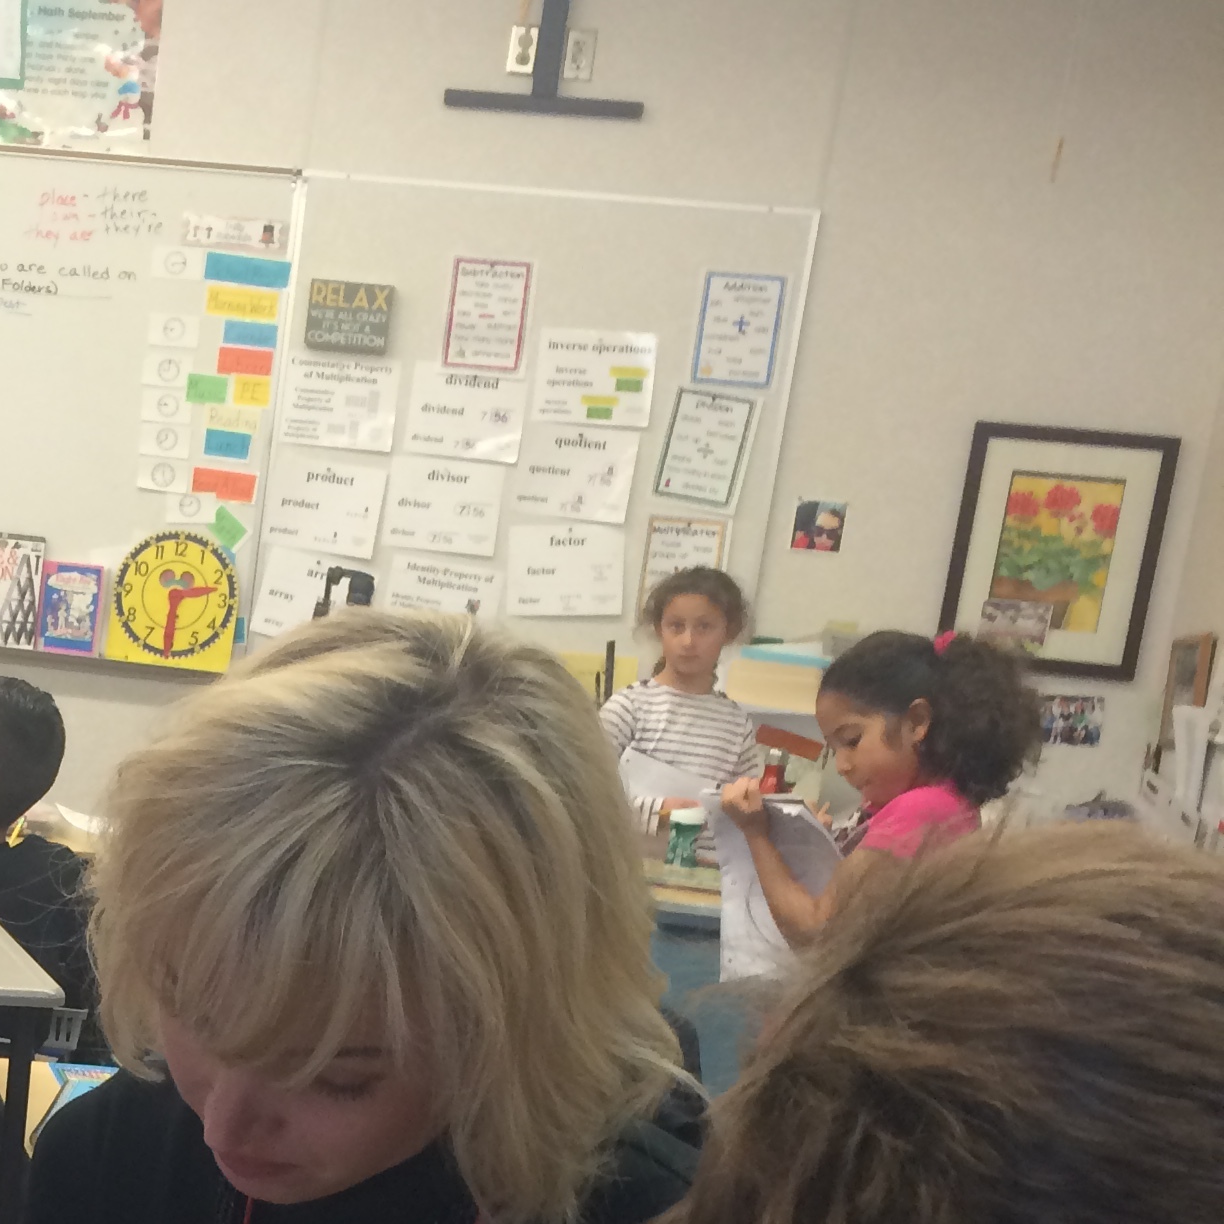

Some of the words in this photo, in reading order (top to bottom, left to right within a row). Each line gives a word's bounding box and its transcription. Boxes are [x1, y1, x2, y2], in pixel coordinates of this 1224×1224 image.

[96, 186, 149, 203] there
[16, 262, 48, 276] are
[57, 263, 112, 281] called
[117, 269, 137, 282] on
[311, 281, 392, 311] RELAX
[307, 329, 386, 348] COMPETITION
[548, 338, 589, 352] inverse
[590, 343, 653, 356] operations
[353, 361, 394, 375] Property
[302, 371, 315, 379] of
[315, 371, 379, 384] Multiplication
[444, 374, 501, 390] dividend
[240, 381, 262, 401] PE
[420, 402, 466, 416] dividend
[554, 434, 608, 451] quotient
[306, 469, 356, 487] product
[427, 468, 471, 484] divisor
[528, 463, 572, 477] quotient
[280, 496, 321, 511] product
[397, 497, 433, 510] divisor
[548, 534, 588, 548] factor
[155, 545, 165, 560] 11
[174, 541, 189, 558] 12
[200, 549, 206, 565] 1
[134, 560, 149, 577] 10
[443, 567, 483, 582] Property
[526, 565, 557, 576] factor
[213, 569, 224, 585] 2
[416, 575, 479, 594] Multiplication
[122, 583, 133, 598] 9
[267, 587, 296, 603] array
[217, 593, 228, 609] 3
[126, 606, 137, 622] 8
[206, 616, 217, 631] 4
[143, 625, 155, 642] 7
[188, 631, 199, 647] 5
